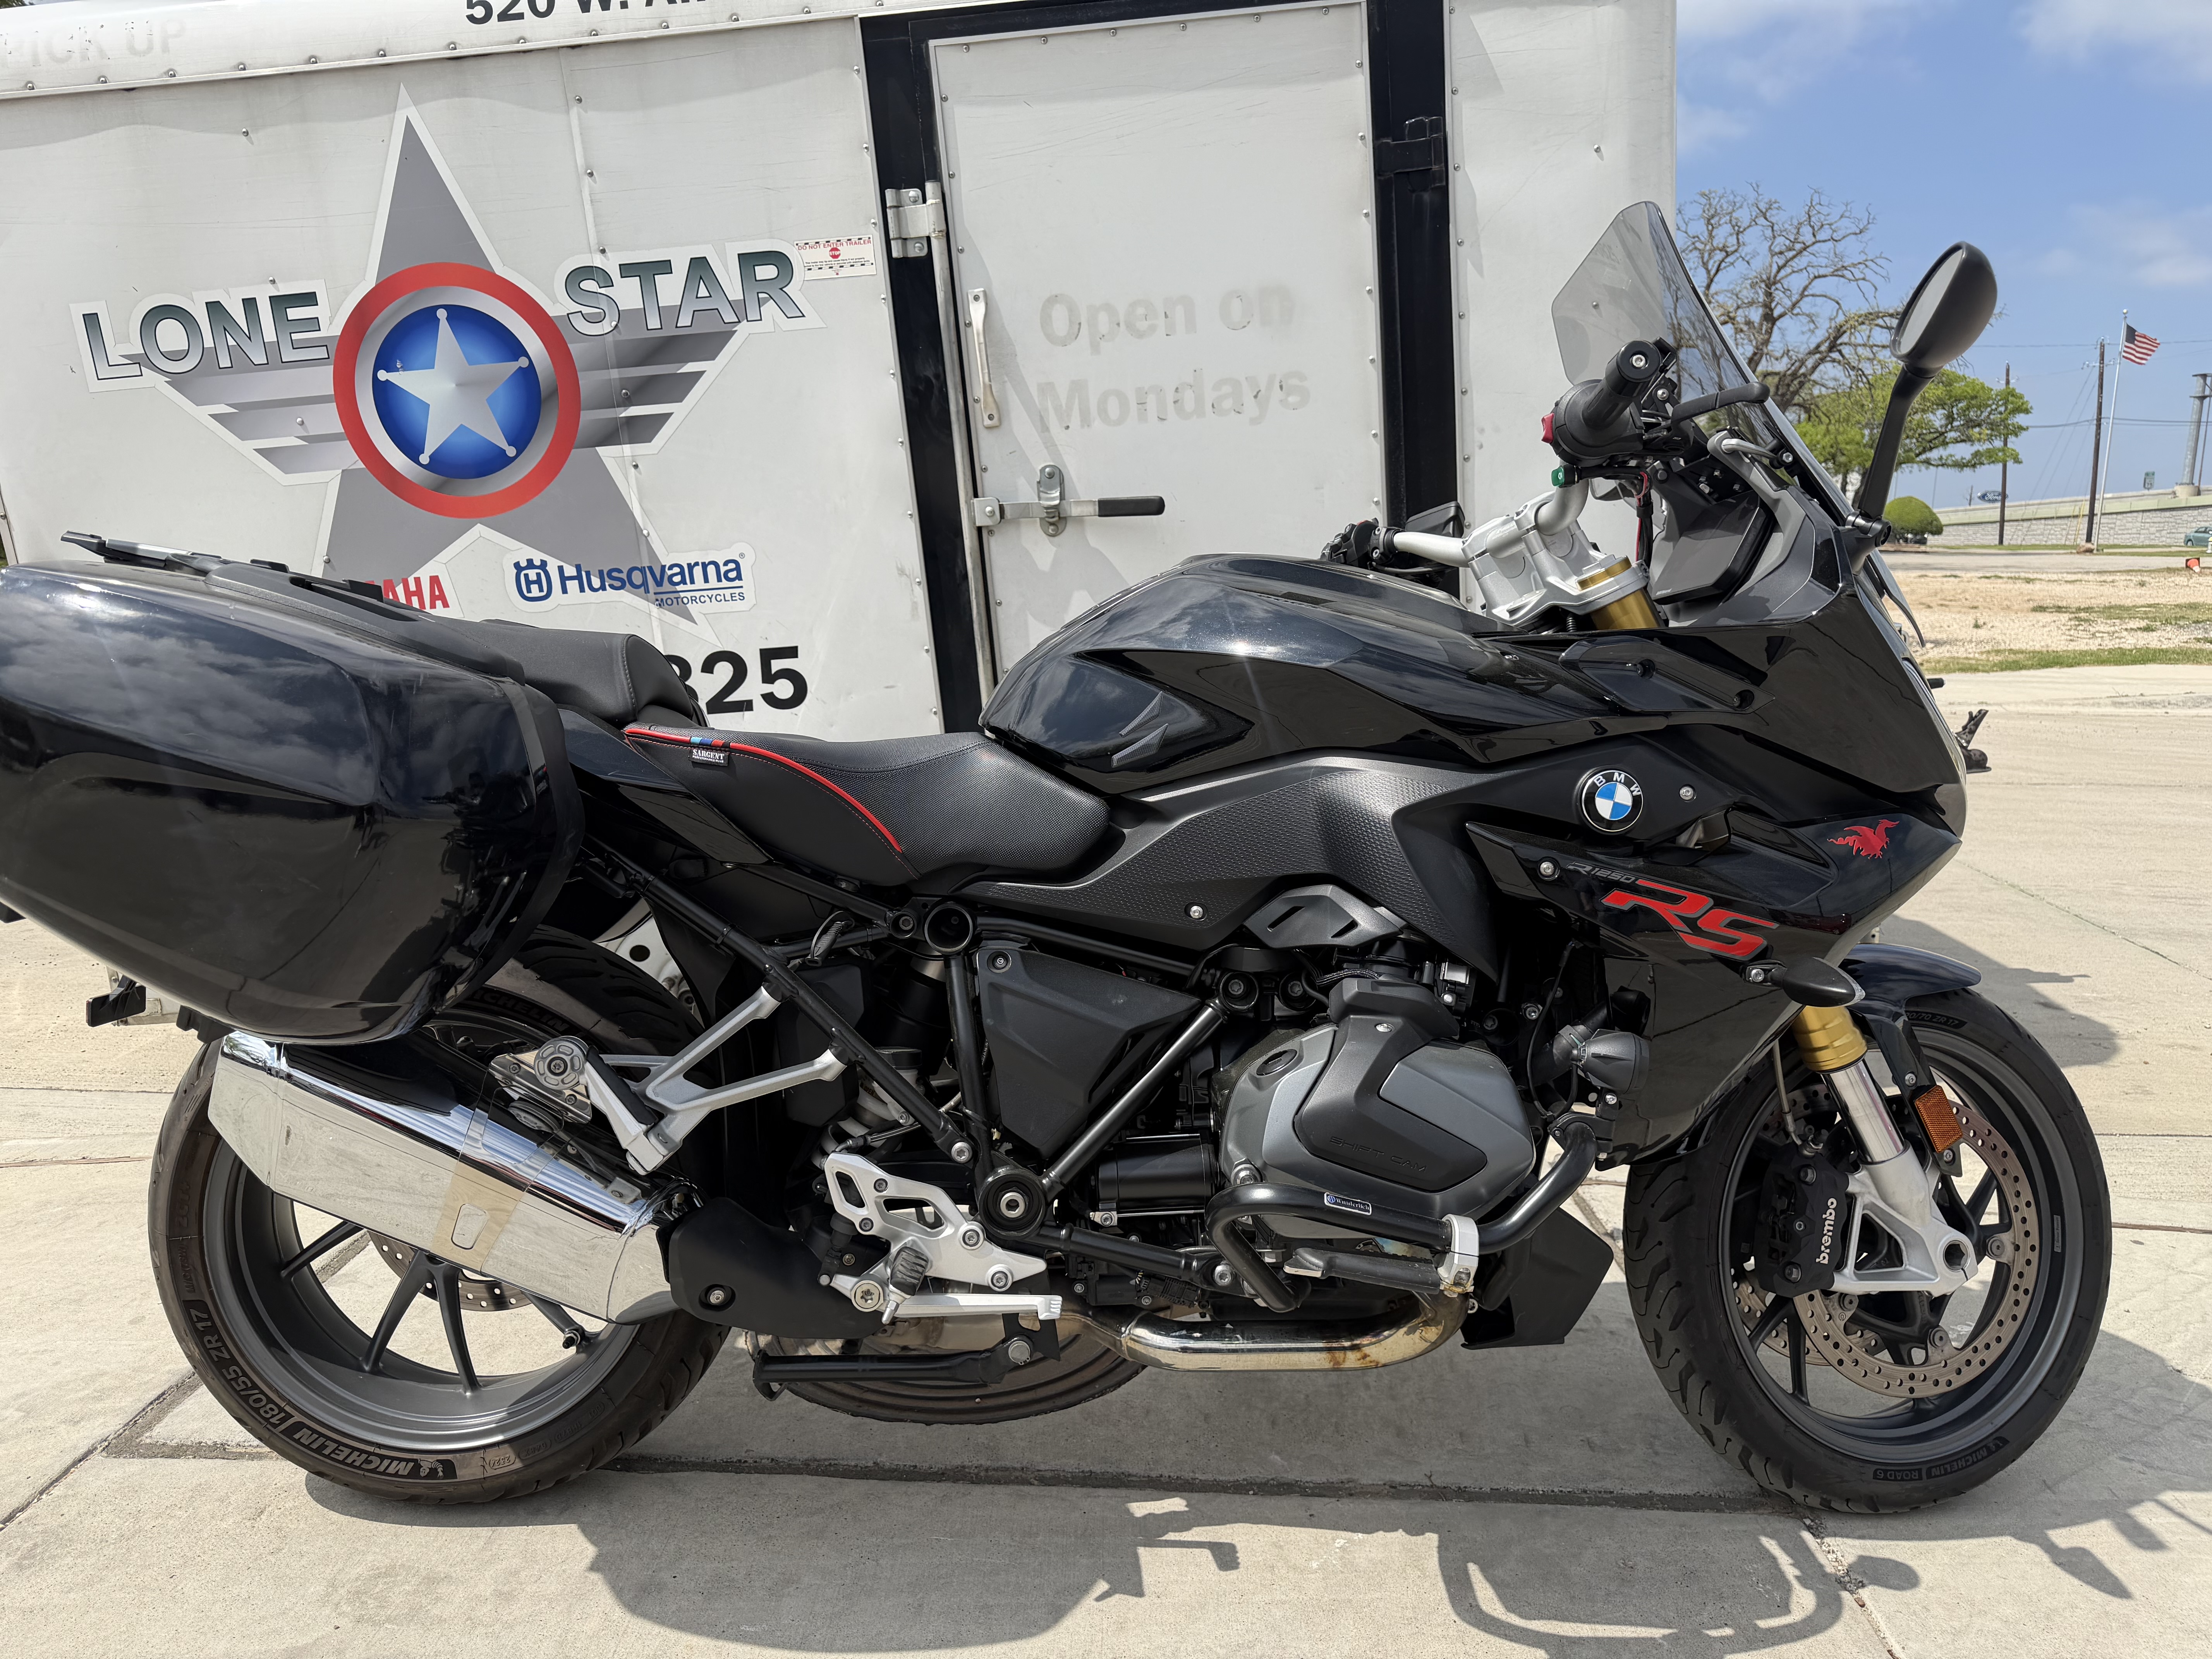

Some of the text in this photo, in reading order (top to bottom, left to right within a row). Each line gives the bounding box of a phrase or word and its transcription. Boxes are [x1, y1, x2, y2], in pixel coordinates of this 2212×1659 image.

[125, 19, 187, 57] UP
[565, 250, 806, 336] STAR
[82, 291, 329, 381] LONE
[1040, 285, 1295, 356] Open on
[1036, 368, 1310, 433] Mondays
[557, 558, 743, 595] Husqvarna
[656, 592, 745, 607] MOTORCYCLES
[693, 749, 725, 759] SARGENT
[1594, 772, 1641, 796] BMW
[1591, 867, 1636, 883] 1250
[1599, 879, 1780, 961] RS
[472, 989, 570, 1032] ICHELIN
[1329, 1136, 1427, 1173] SHIFT CAM
[1336, 1198, 1369, 1210] Wunderlich
[1816, 1198, 1837, 1264] brembo
[190, 1309, 414, 1475] MICHELIN 180/55 ZR 17
[1877, 1448, 1988, 1480] MICHELIN ROAD 6
